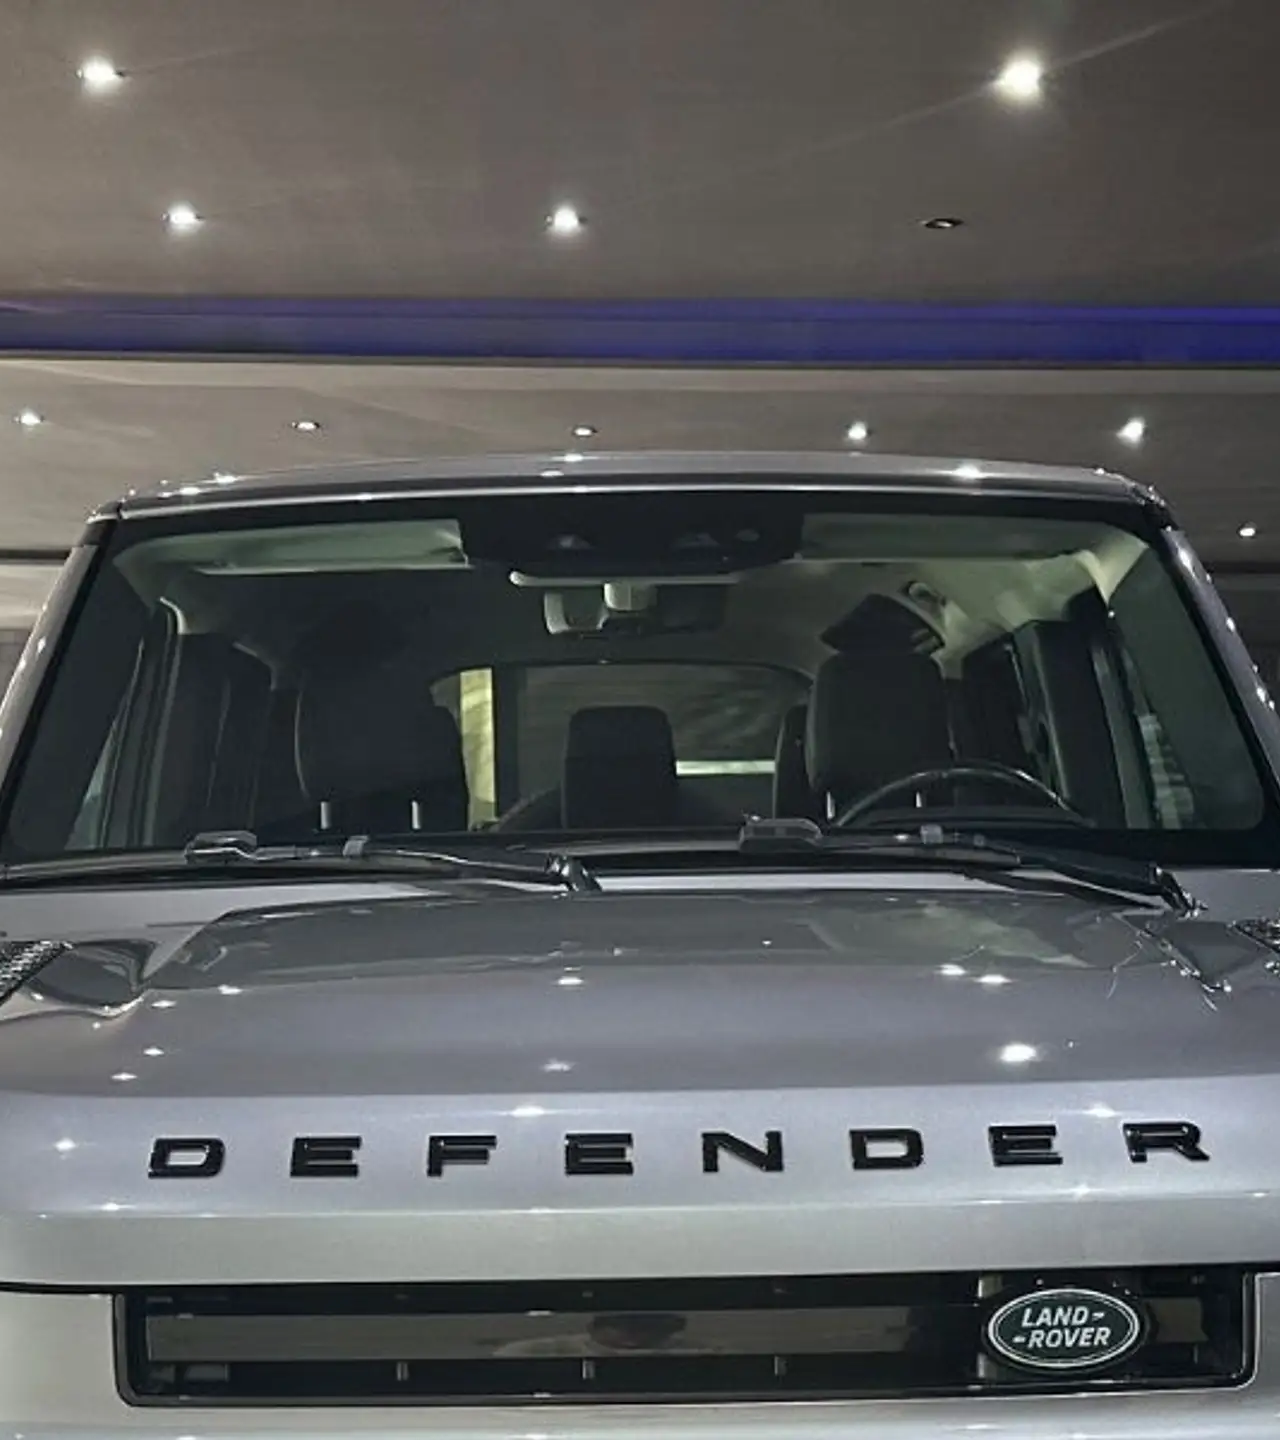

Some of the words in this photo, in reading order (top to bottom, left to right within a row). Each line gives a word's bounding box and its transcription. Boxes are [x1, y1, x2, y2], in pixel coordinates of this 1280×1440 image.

[148, 1121, 1210, 1178] DEFENDER
[1021, 1305, 1089, 1328] LAND
[1027, 1326, 1112, 1349] ROVER
